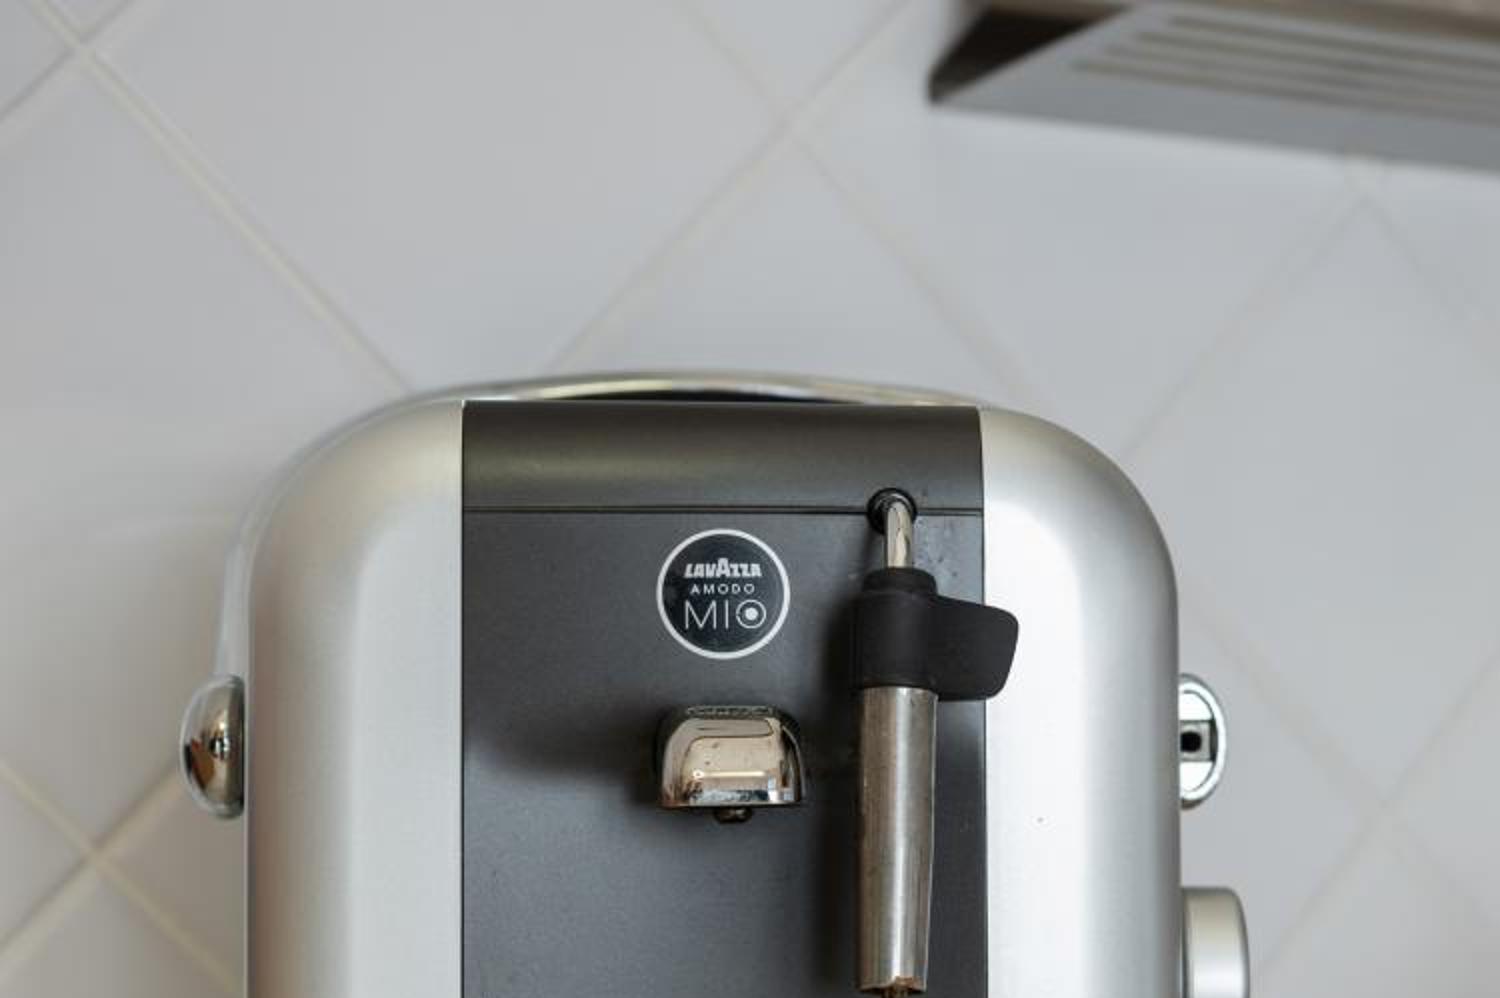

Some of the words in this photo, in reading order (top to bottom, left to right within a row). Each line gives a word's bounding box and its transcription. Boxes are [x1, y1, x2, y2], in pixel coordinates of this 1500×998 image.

[684, 557, 762, 578] LAVAZZA
[690, 583, 755, 595] AMODO
[685, 599, 767, 629] MIO
